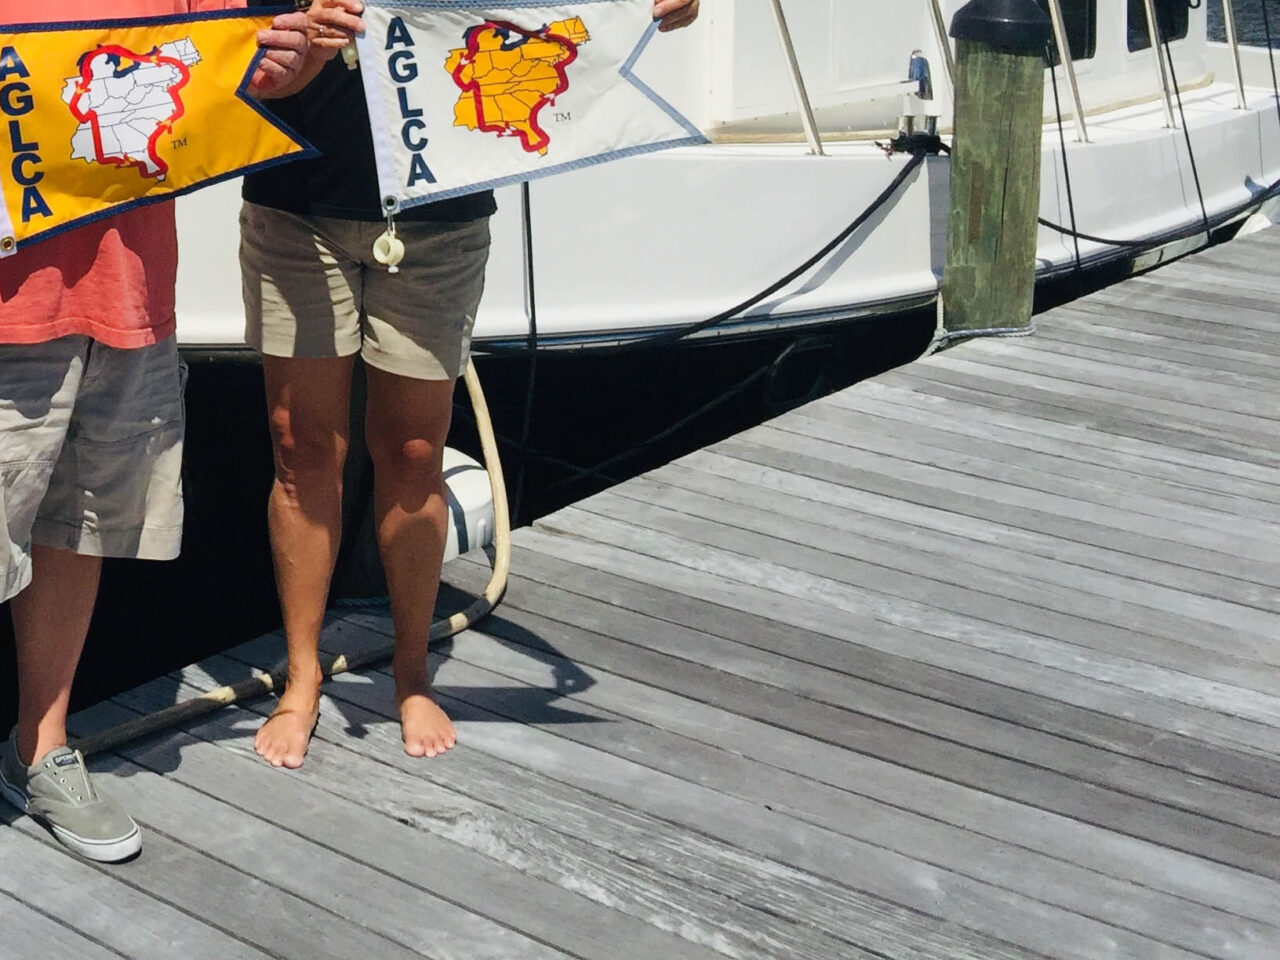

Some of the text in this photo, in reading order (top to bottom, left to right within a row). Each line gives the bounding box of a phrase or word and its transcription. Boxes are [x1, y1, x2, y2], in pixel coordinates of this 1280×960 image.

[384, 16, 438, 188] AGLCA
[552, 111, 571, 122] TM
[170, 137, 188, 150] TM
